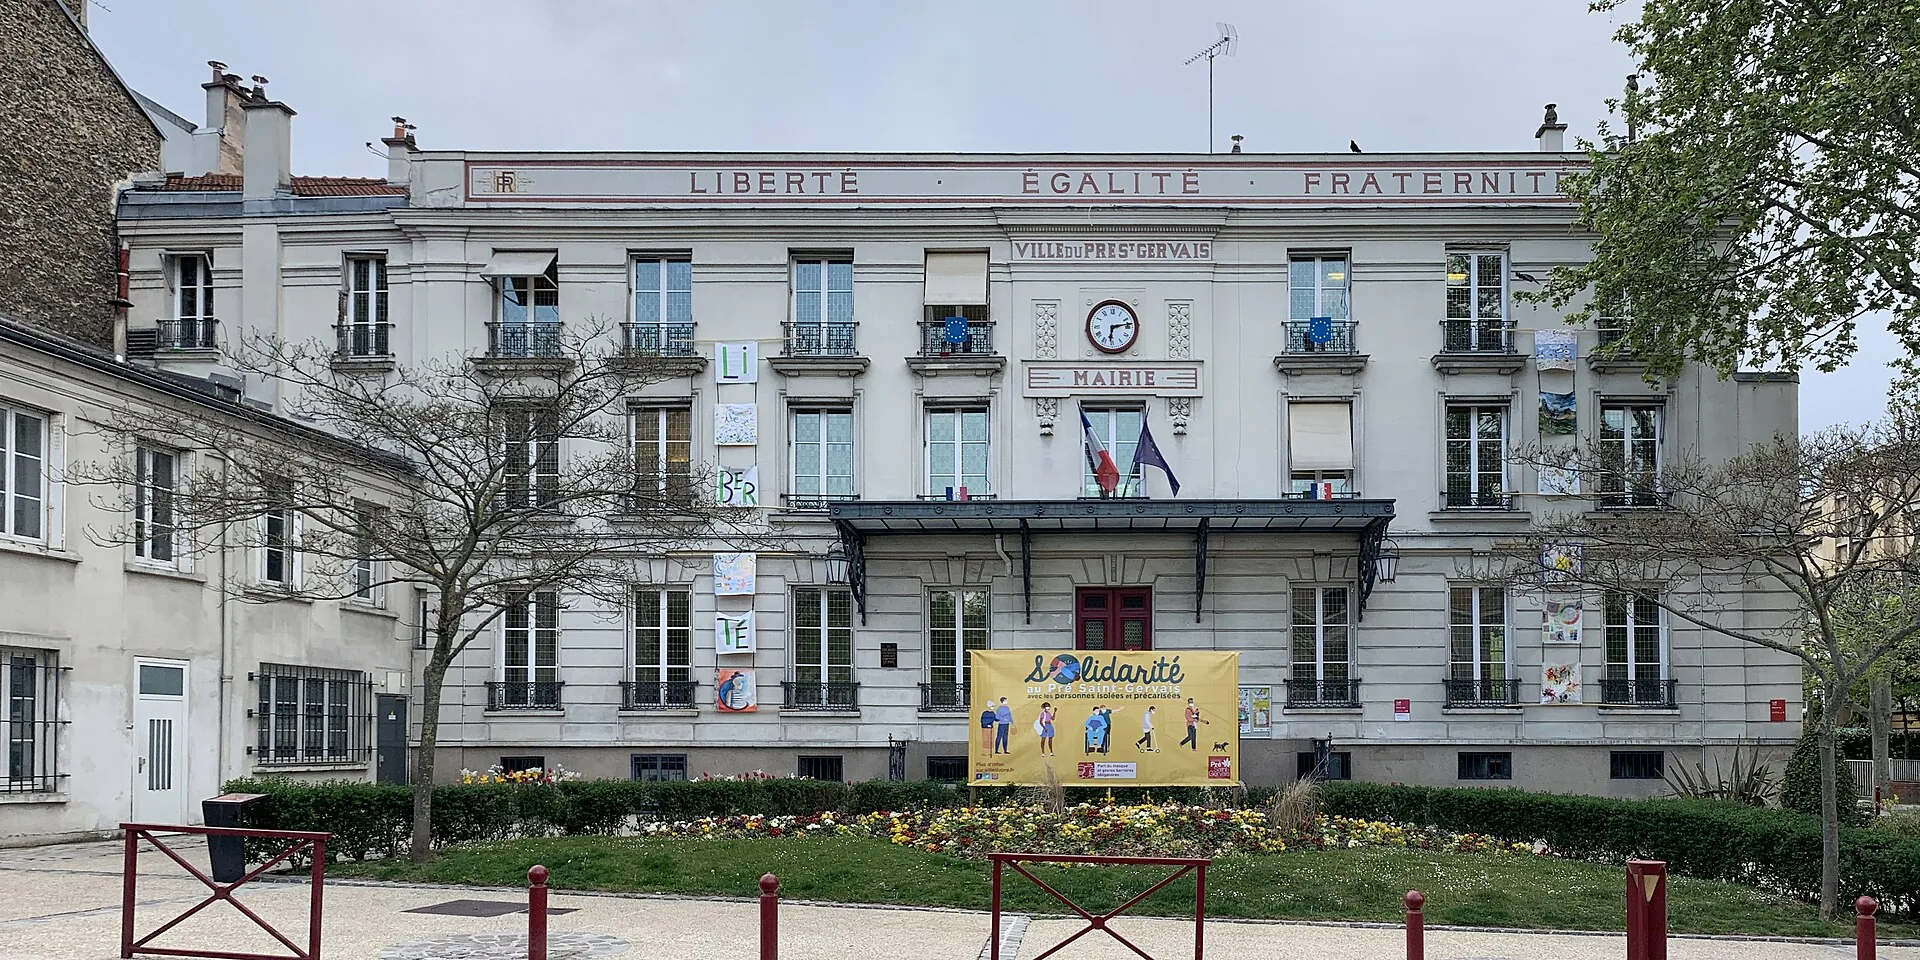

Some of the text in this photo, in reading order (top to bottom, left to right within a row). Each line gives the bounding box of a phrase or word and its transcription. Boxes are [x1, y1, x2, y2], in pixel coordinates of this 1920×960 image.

[690, 168, 859, 194] LIBERTÉ
[1021, 168, 1200, 194] ÉGALITÉ
[1014, 242, 1064, 258] VILLE
[1064, 246, 1083, 258] DU
[1136, 242, 1210, 259] GERVAIS
[1073, 370, 1156, 386] MAIRIE
[718, 470, 757, 504] BER
[716, 617, 749, 649] TÉ
[1024, 653, 1185, 685] Solidarité
[1026, 683, 1181, 693] au Pré Saint-Gervais
[1133, 692, 1181, 700] précarisées
